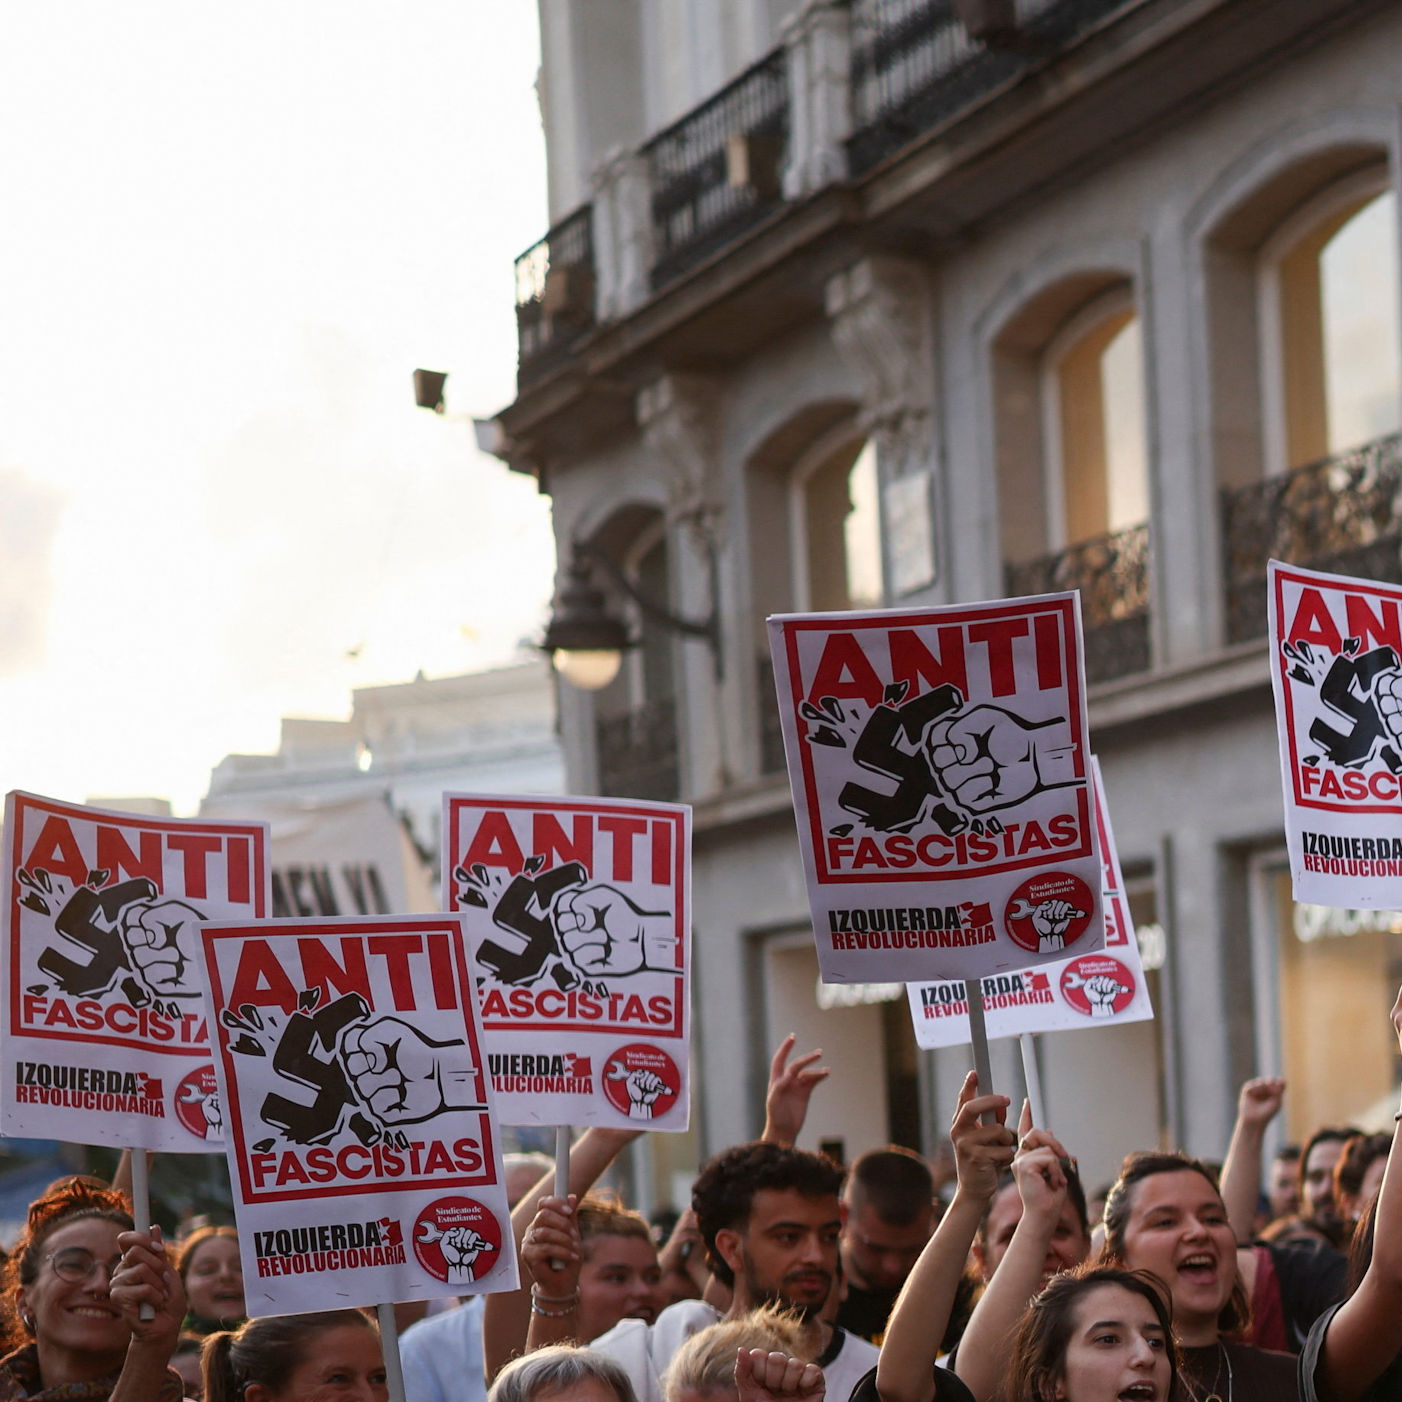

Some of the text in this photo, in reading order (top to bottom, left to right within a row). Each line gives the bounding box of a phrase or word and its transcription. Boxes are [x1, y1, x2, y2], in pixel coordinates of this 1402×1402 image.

[807, 614, 1063, 707] ANTI
[464, 811, 671, 885] ANTI
[827, 814, 1078, 869] FASCISTAS
[26, 815, 250, 904] ANTI
[1029, 881, 1065, 892] Sindicato
[829, 906, 959, 934] IZQUIERDA
[832, 925, 996, 950] REVOLUCIONARIA
[229, 935, 457, 1015] ANTI
[921, 974, 1024, 1006] IZQURDA
[24, 995, 208, 1043] FASCIST
[17, 1062, 138, 1095] IZQUIERDA
[488, 1053, 564, 1076] UIERDA
[492, 1075, 593, 1094] LUCIONARIA
[16, 1085, 165, 1118] REVOLUCIONARIA
[250, 1138, 482, 1188] FASCISTAS
[254, 1222, 382, 1258] IZQUIERDA
[256, 1245, 406, 1278] REVOLUCIONARIA
